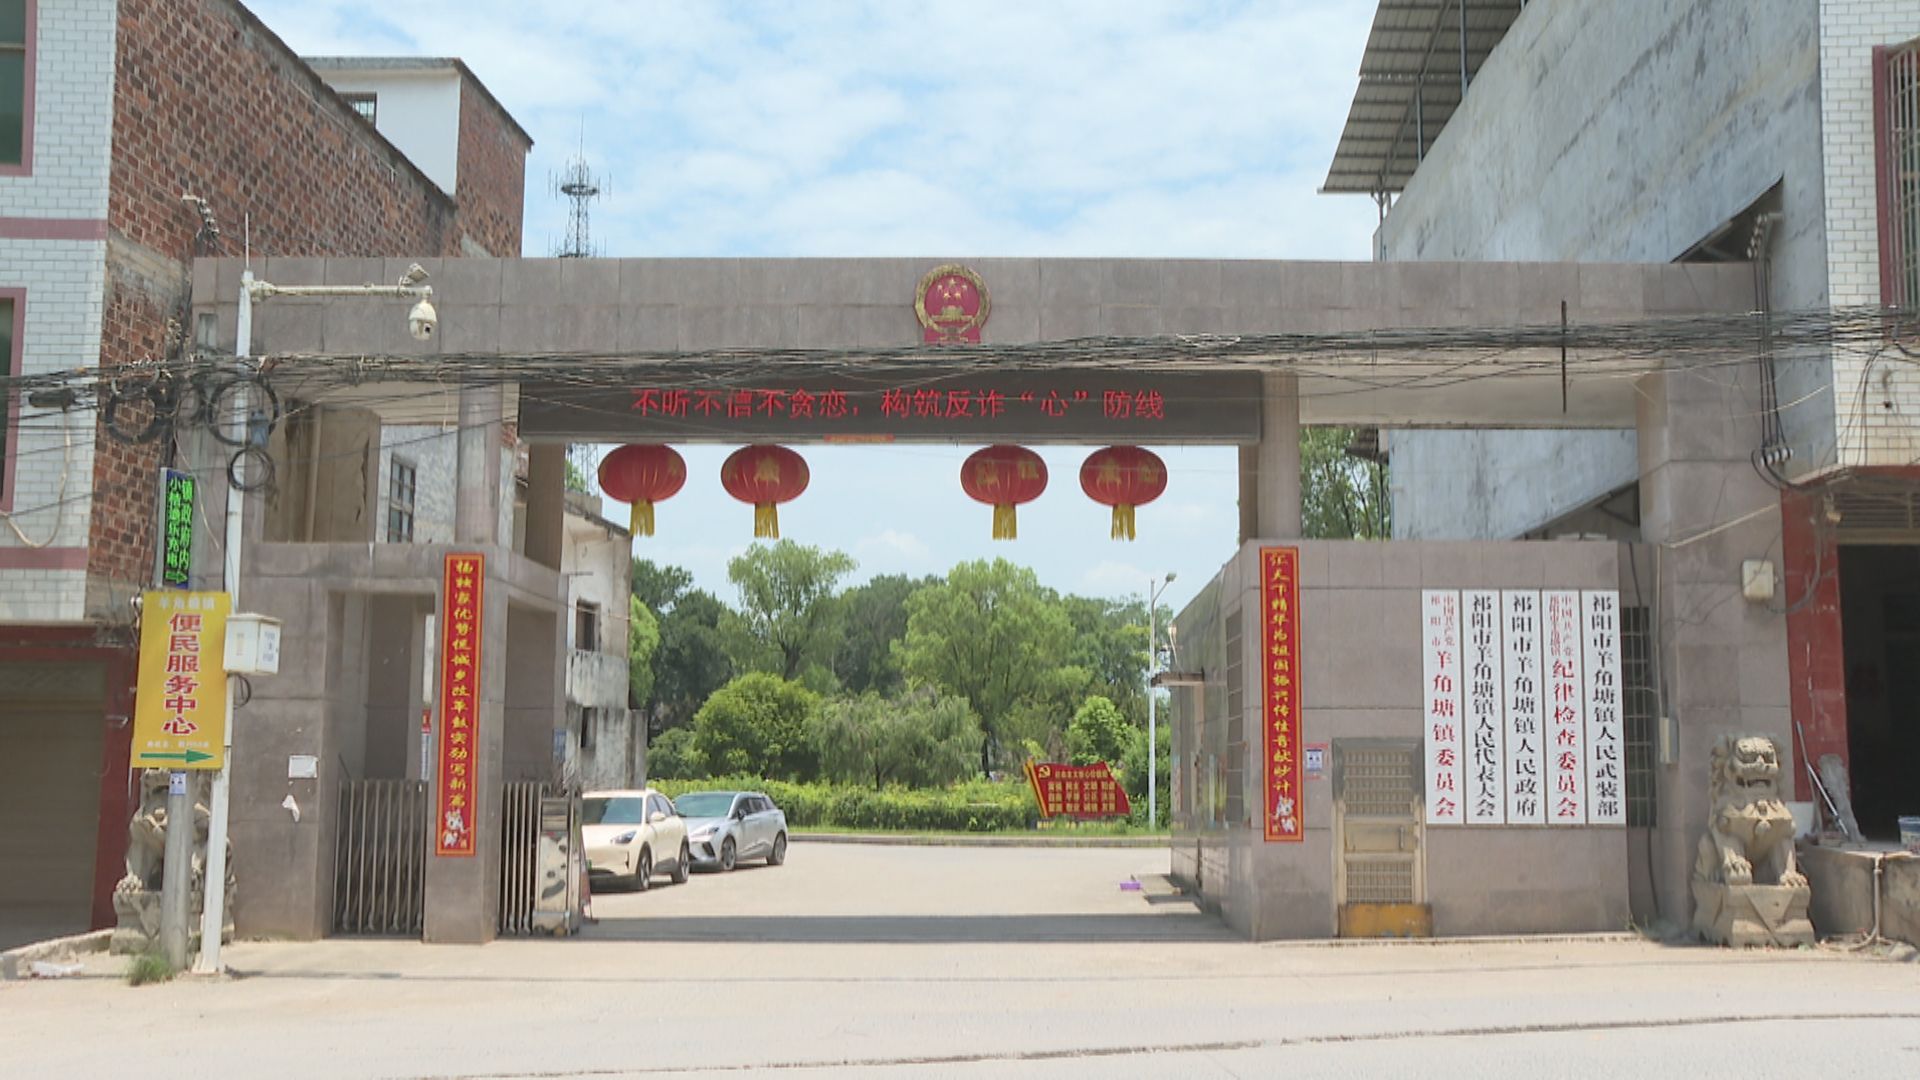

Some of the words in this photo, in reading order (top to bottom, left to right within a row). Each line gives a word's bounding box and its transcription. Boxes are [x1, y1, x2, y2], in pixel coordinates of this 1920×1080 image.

[163, 614, 202, 736] 便民服务中心
[1431, 651, 1457, 817] 羊角塘镇委员会
[1472, 594, 1496, 817] 祁阳市羊角塘镇人民代表大会
[1512, 594, 1537, 817] 祁阳市羊角塘镇人民政府
[1552, 658, 1577, 817] 纪律检查委员会
[1592, 594, 1618, 817] 祁阳市羊角塘镇人民武装部
